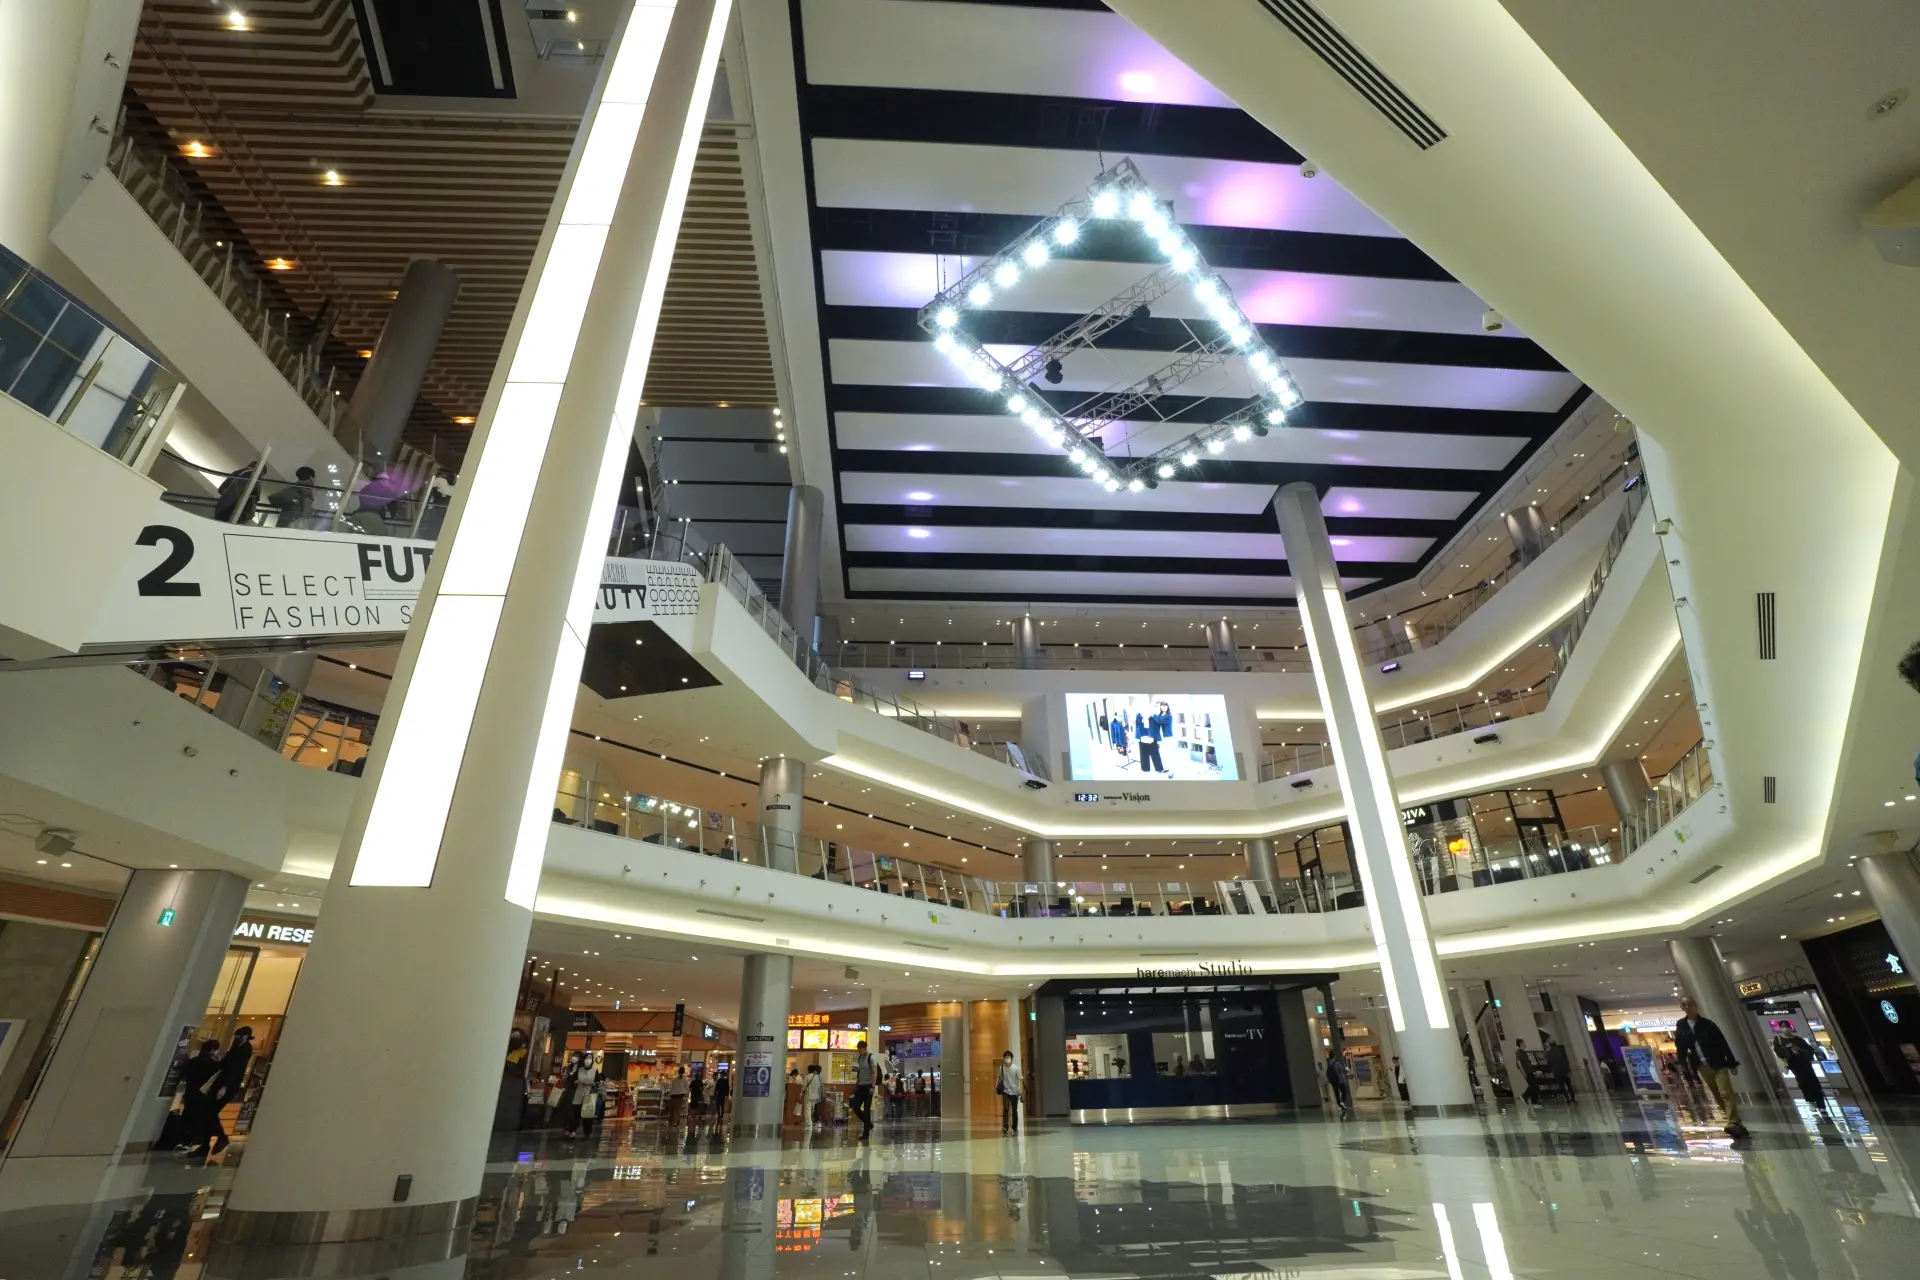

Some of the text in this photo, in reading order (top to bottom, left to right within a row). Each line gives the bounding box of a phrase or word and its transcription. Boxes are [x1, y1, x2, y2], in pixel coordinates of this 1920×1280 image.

[135, 525, 202, 597] 2
[233, 573, 356, 597] SELECT
[595, 584, 647, 609] UTY
[240, 605, 381, 629] FASHION
[1122, 792, 1151, 802] Vision
[1136, 959, 1252, 979] haremachi Studio
[1246, 1028, 1265, 1040] TV
